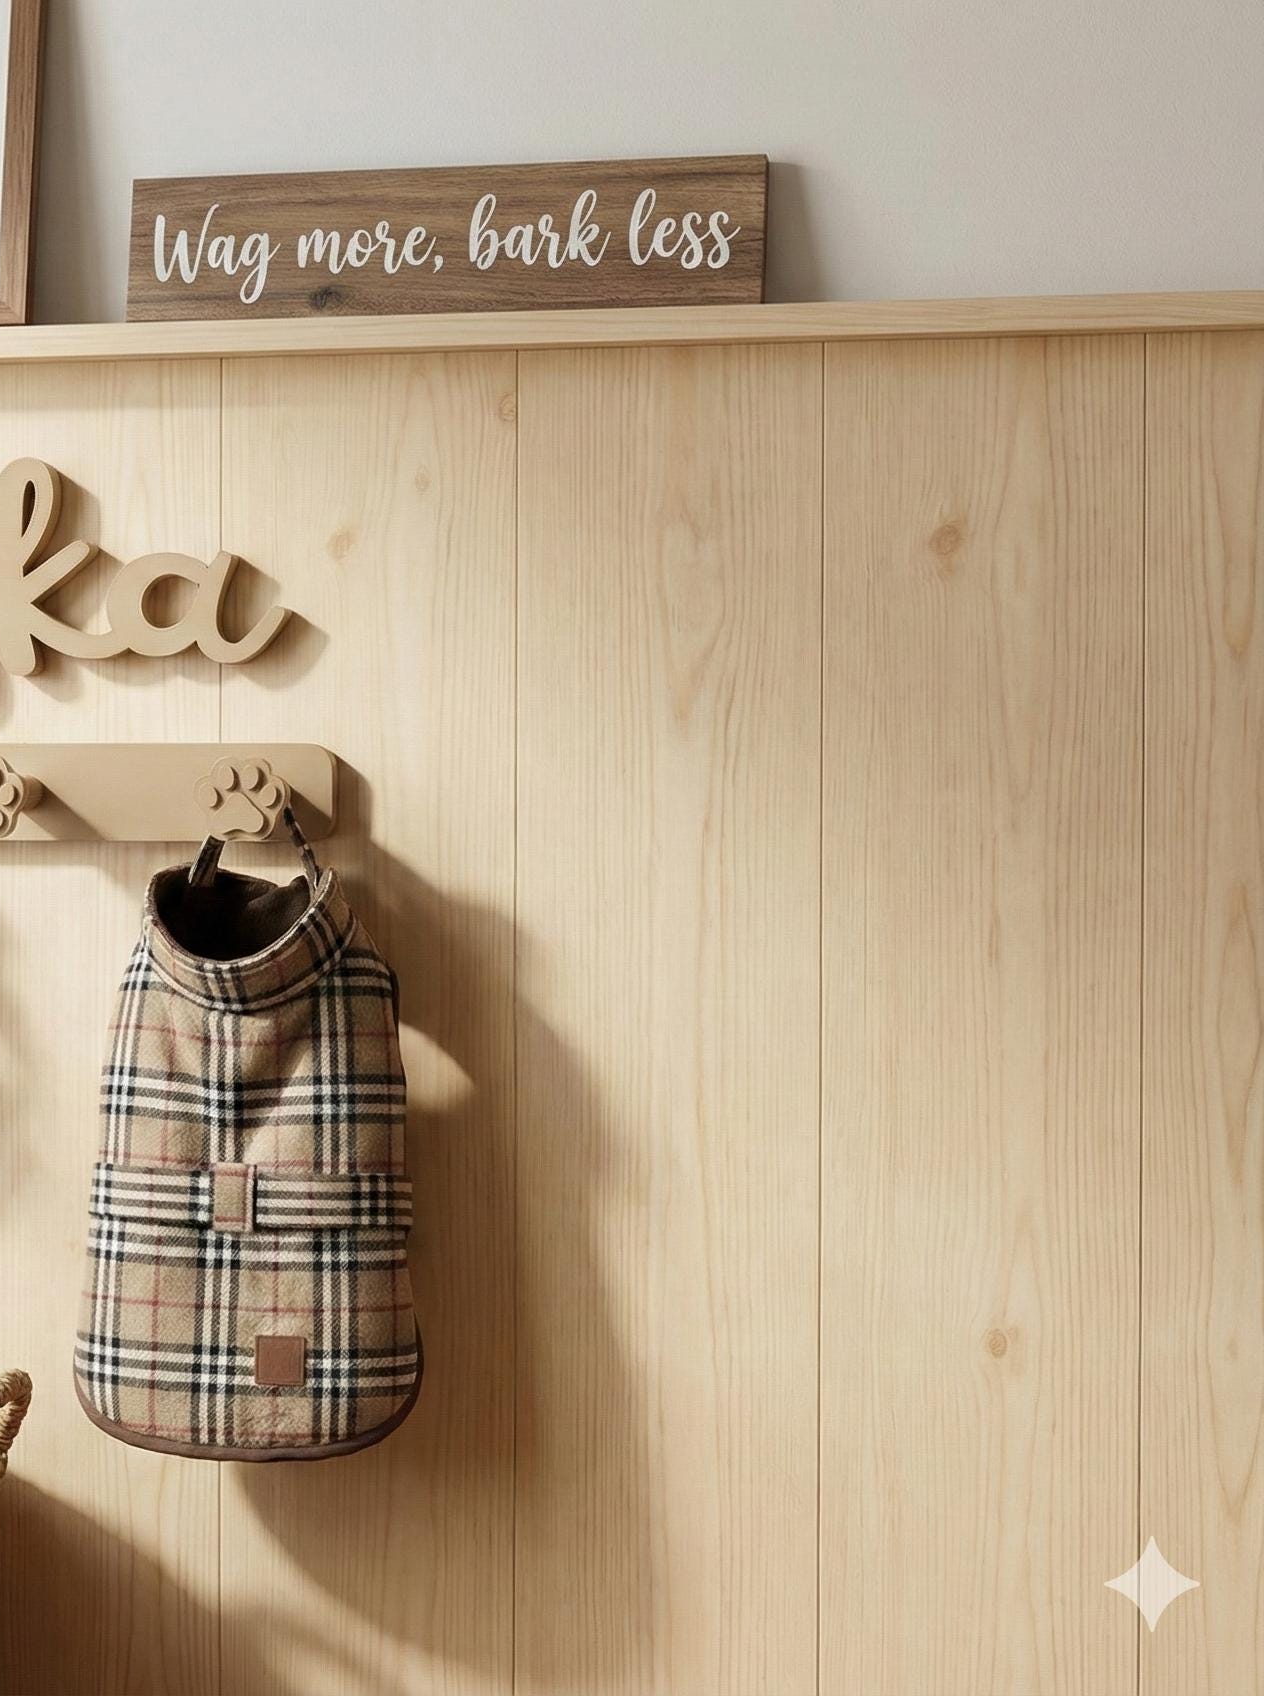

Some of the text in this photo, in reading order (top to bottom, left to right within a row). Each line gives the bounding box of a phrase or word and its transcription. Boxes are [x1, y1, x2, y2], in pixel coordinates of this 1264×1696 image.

[154, 187, 742, 304] Wag more, bark less
